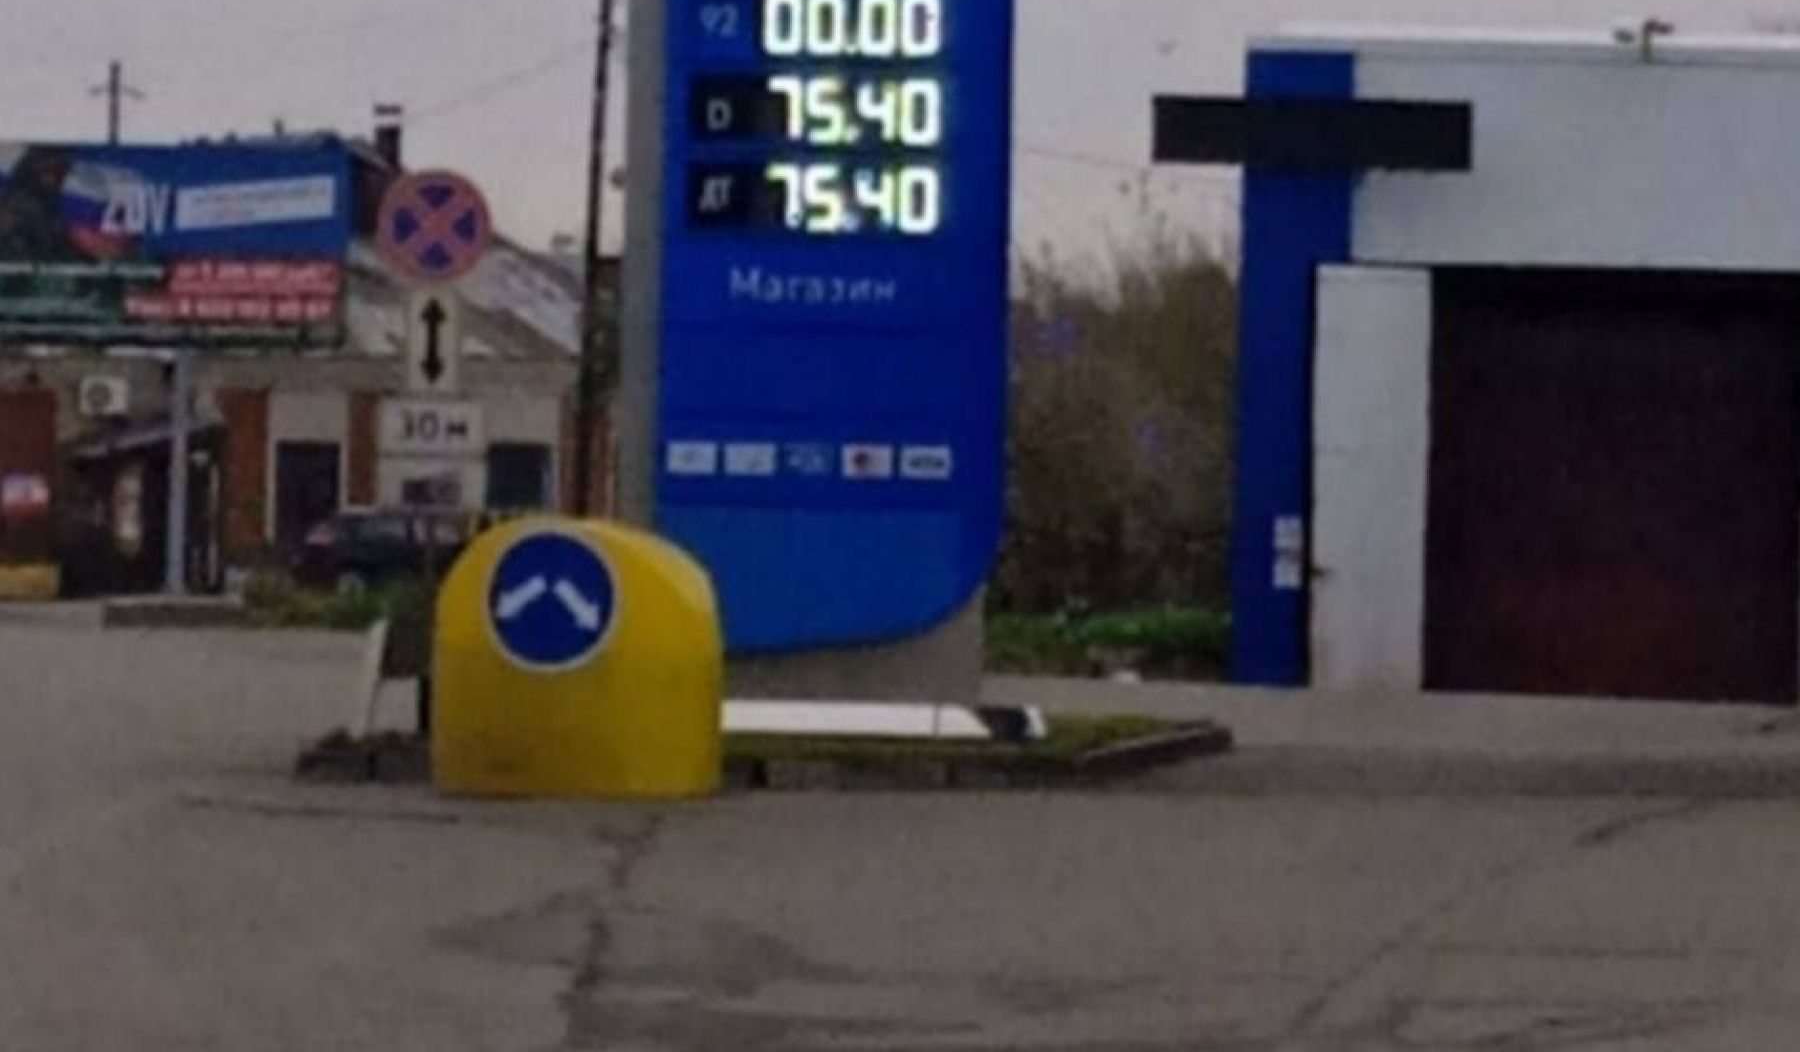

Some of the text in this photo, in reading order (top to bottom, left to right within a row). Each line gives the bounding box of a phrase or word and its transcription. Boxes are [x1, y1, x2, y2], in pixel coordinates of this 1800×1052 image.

[702, 4, 739, 38] 92
[767, 75, 940, 145] 75.40
[764, 163, 939, 234] 75.40
[729, 266, 896, 304] Магазин
